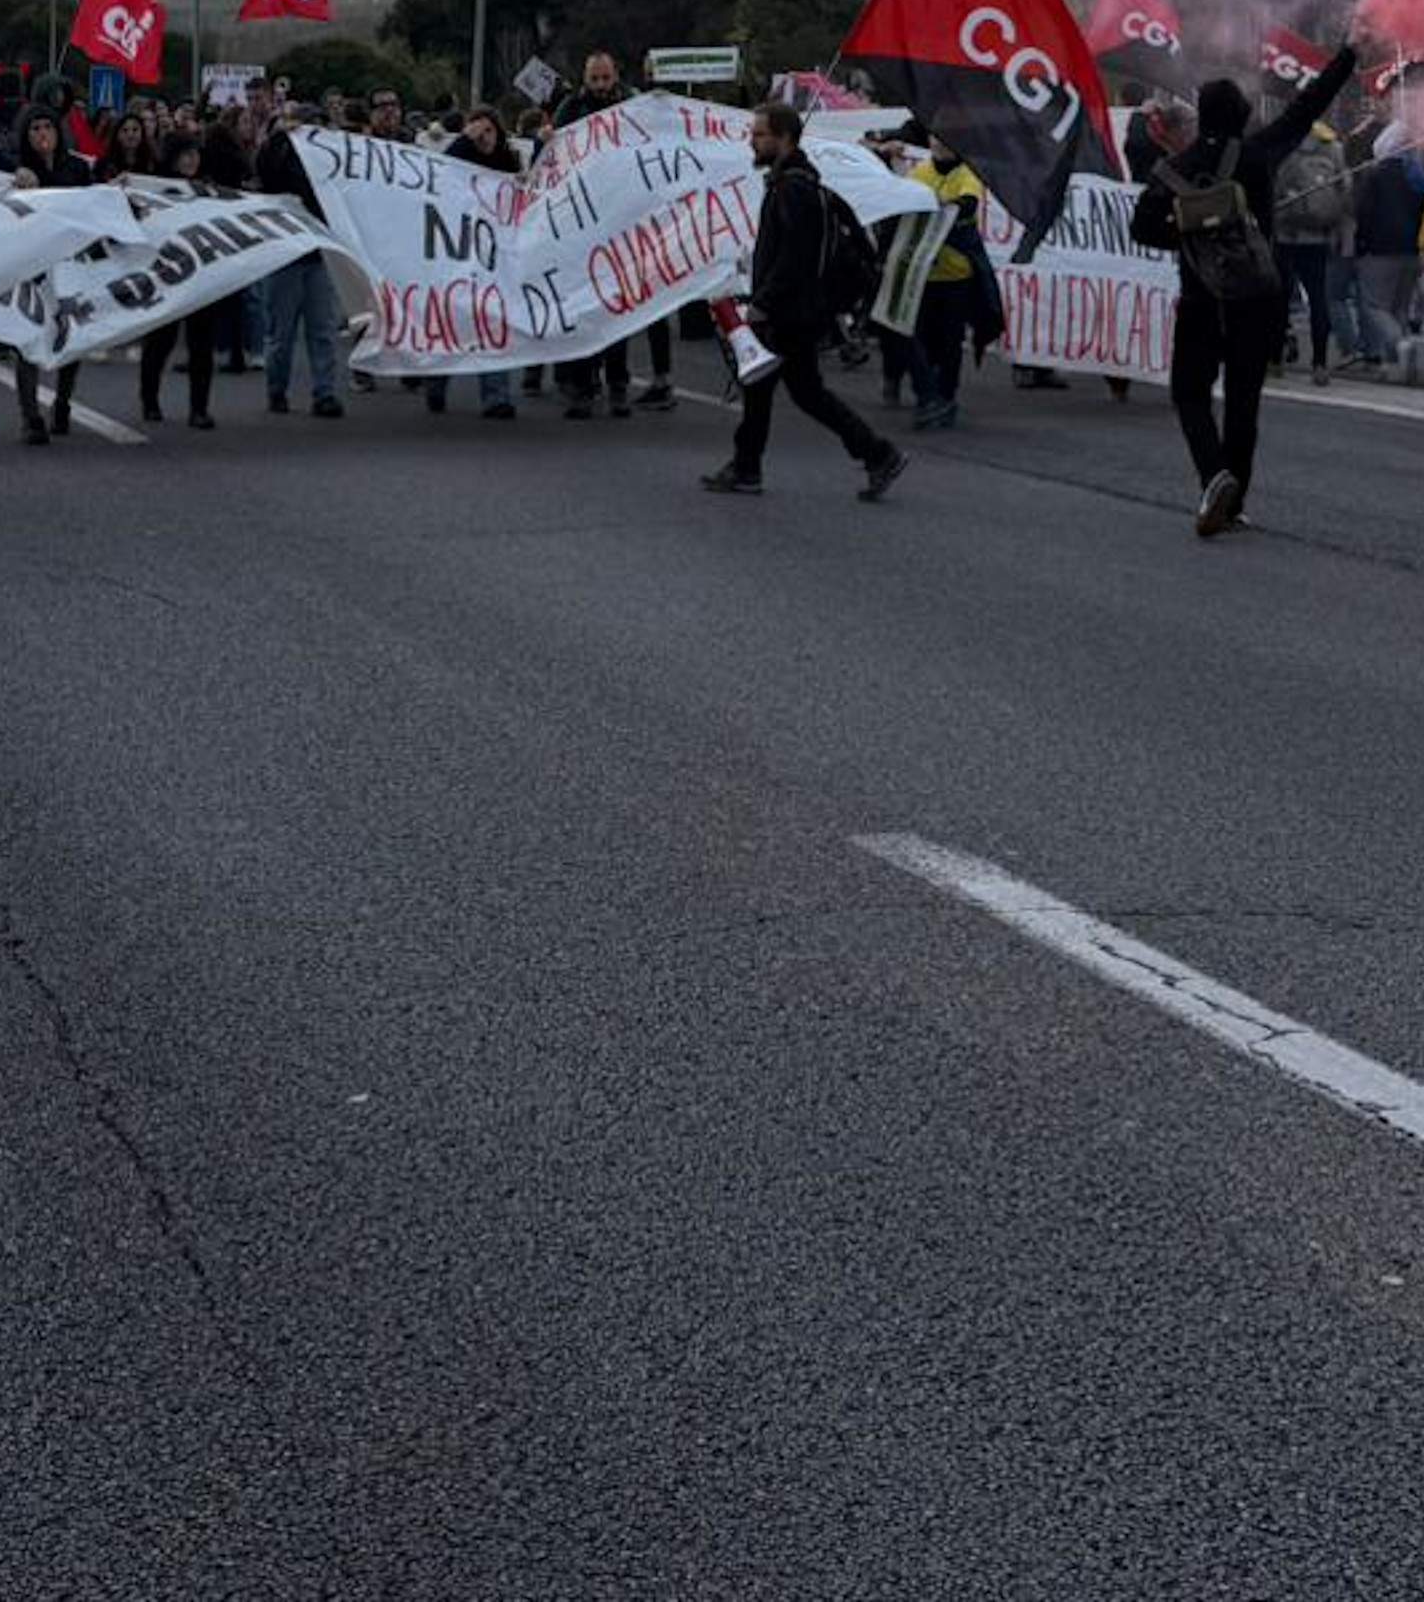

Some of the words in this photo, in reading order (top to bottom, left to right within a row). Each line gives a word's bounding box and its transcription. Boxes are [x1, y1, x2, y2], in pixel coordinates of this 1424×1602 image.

[960, 6, 1080, 141] CGT
[306, 129, 442, 196] SENSE
[423, 202, 497, 272] NO
[546, 169, 599, 241] HI
[635, 146, 705, 192] HA
[521, 266, 576, 340] DE
[588, 174, 756, 315] QUALITAT
